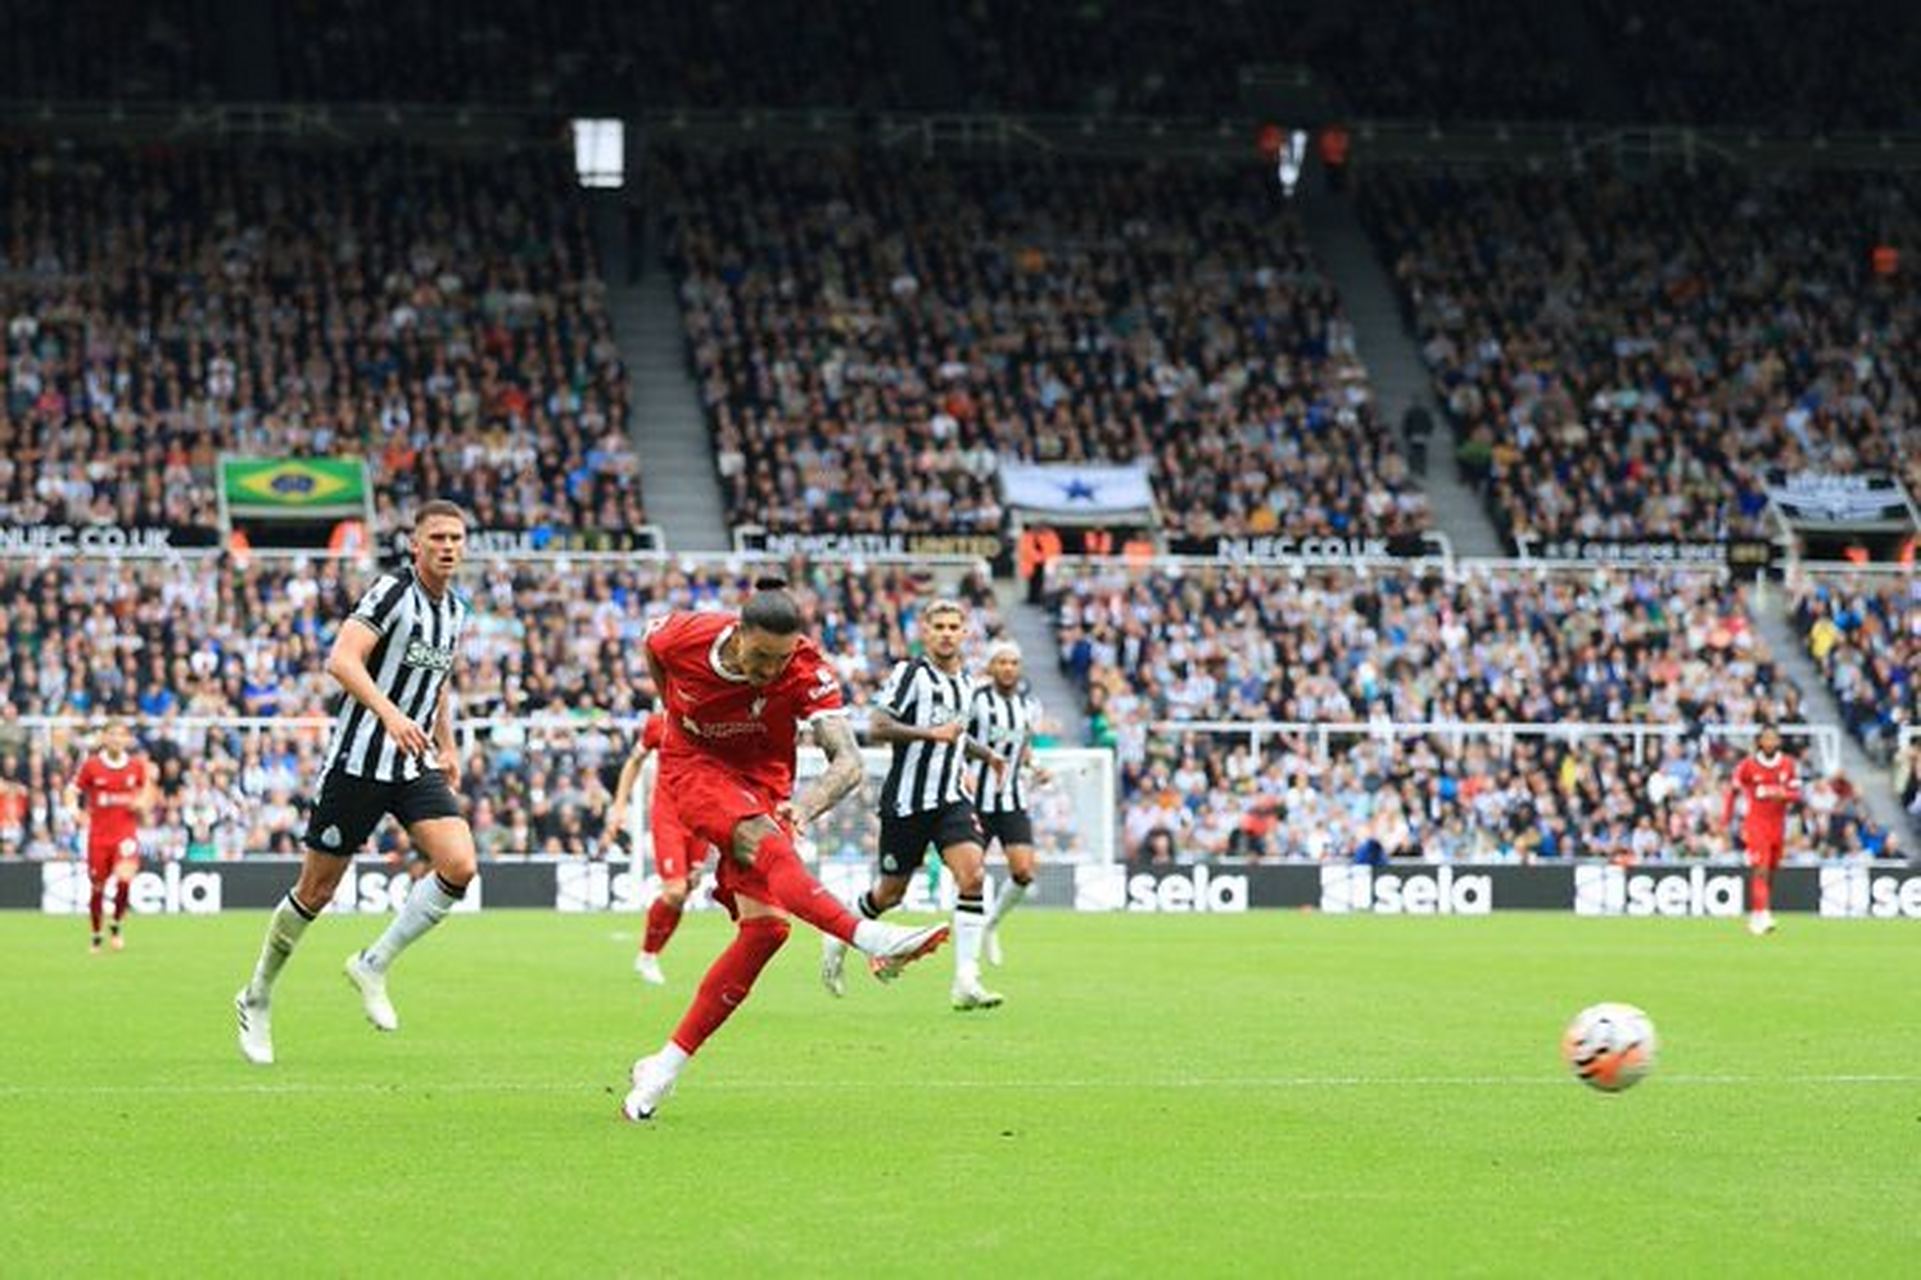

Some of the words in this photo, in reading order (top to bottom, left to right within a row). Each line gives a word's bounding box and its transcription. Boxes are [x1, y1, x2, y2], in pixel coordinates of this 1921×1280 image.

[1129, 863, 1248, 913] sela
[1374, 863, 1492, 914] sela
[1627, 864, 1744, 916] sela
